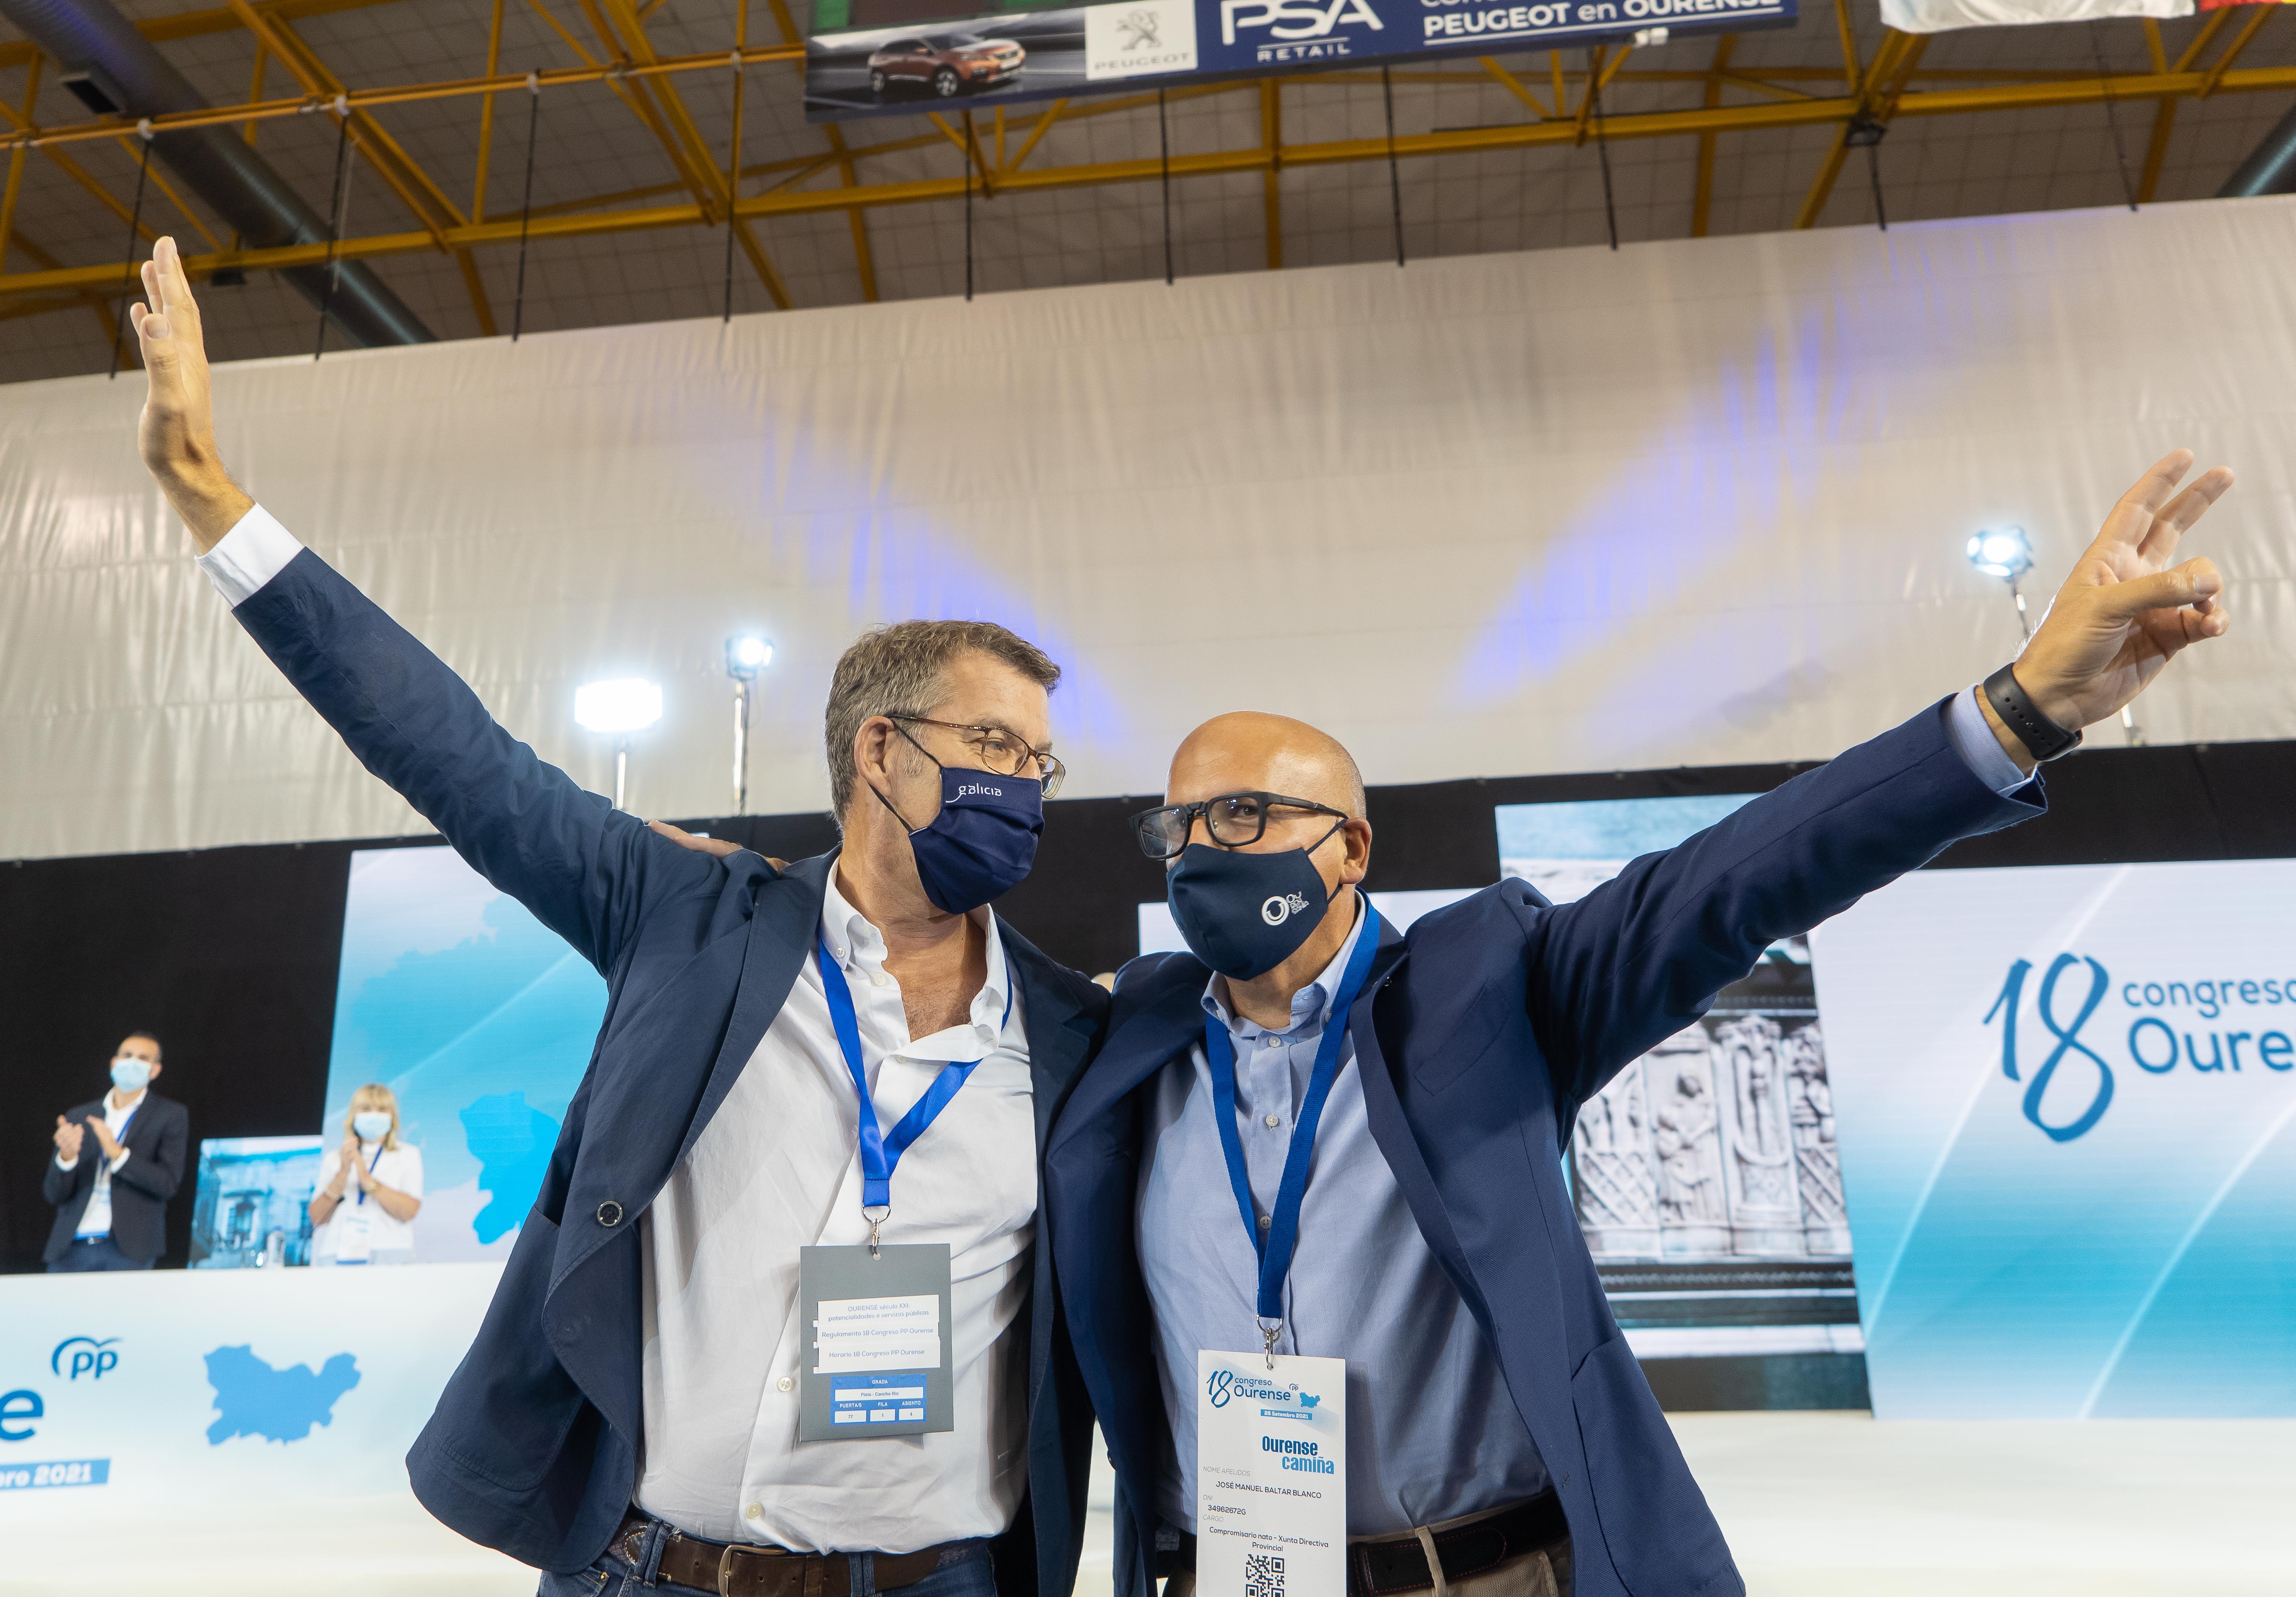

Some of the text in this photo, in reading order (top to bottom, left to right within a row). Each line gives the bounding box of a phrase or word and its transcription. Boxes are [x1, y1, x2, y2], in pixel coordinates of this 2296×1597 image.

[1222, 0, 1384, 45] PSA
[1424, 3, 1571, 37] PEUGEOT
[1577, 3, 1617, 21] en
[1094, 52, 1189, 70] PEUGEOT
[1257, 43, 1351, 62] RETAIL
[946, 783, 1002, 802] galicia
[1982, 952, 2115, 1145] 18
[828, 1313, 875, 1322] potencialidades
[1206, 1370, 1233, 1408] 18
[1235, 1378, 1272, 1387] congreso
[1234, 1385, 1291, 1400] Ourense
[1262, 1436, 1318, 1456] Ourense
[1221, 1468, 1250, 1476] APELIDOS
[1282, 1456, 1334, 1474] camiña
[1235, 1483, 1263, 1492] MANUEL
[1265, 1487, 1291, 1495] BALTAR
[1293, 1490, 1321, 1499] BLANCO
[1208, 1505, 1246, 1515] 34962672G
[1209, 1527, 1257, 1538] Compromisario
[1279, 1535, 1297, 1544] Xunta
[1299, 1538, 1328, 1548] Directiva
[1252, 1542, 1283, 1552] Provincial
